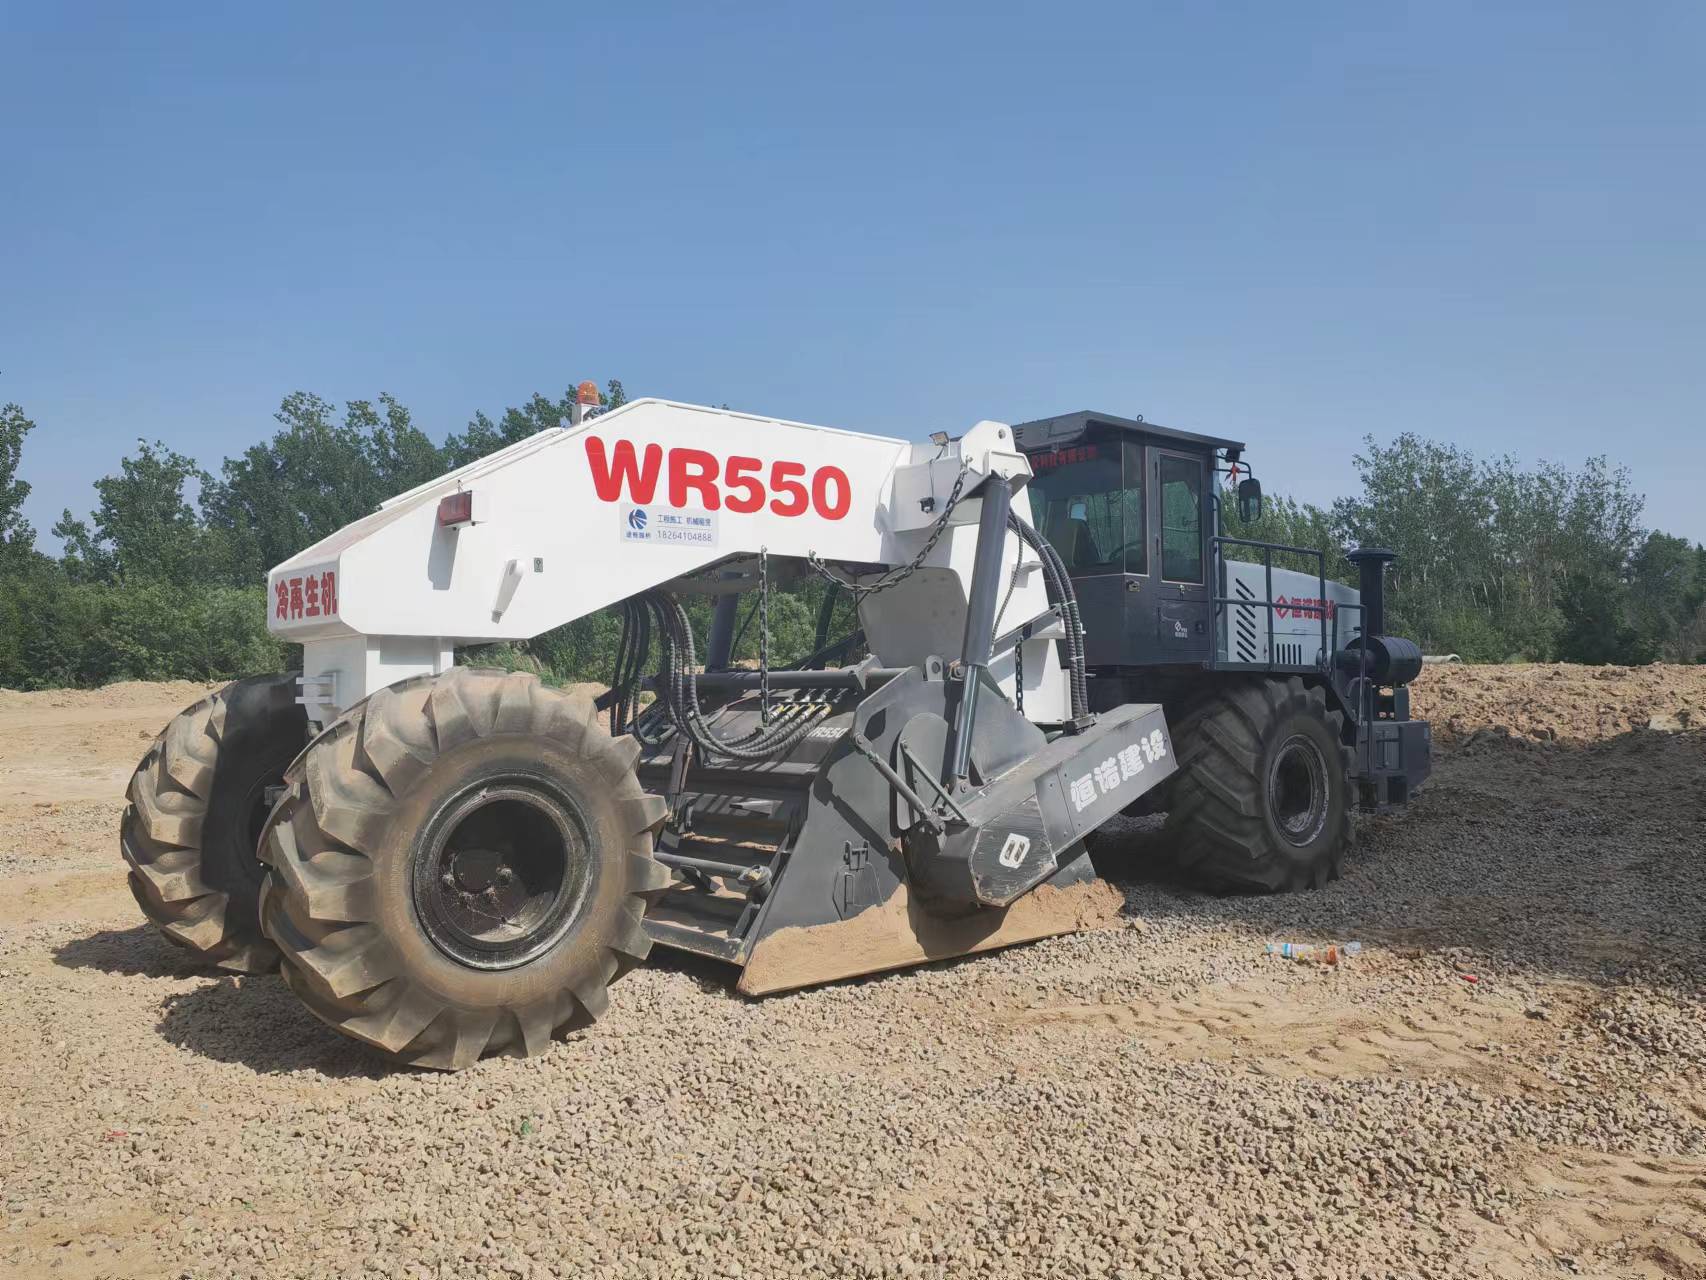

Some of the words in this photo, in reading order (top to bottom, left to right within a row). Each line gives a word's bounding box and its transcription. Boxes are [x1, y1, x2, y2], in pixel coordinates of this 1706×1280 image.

[585, 436, 851, 521] WR550
[275, 571, 337, 620] 冷再生机
[1071, 728, 1167, 812] 恒诺建设
